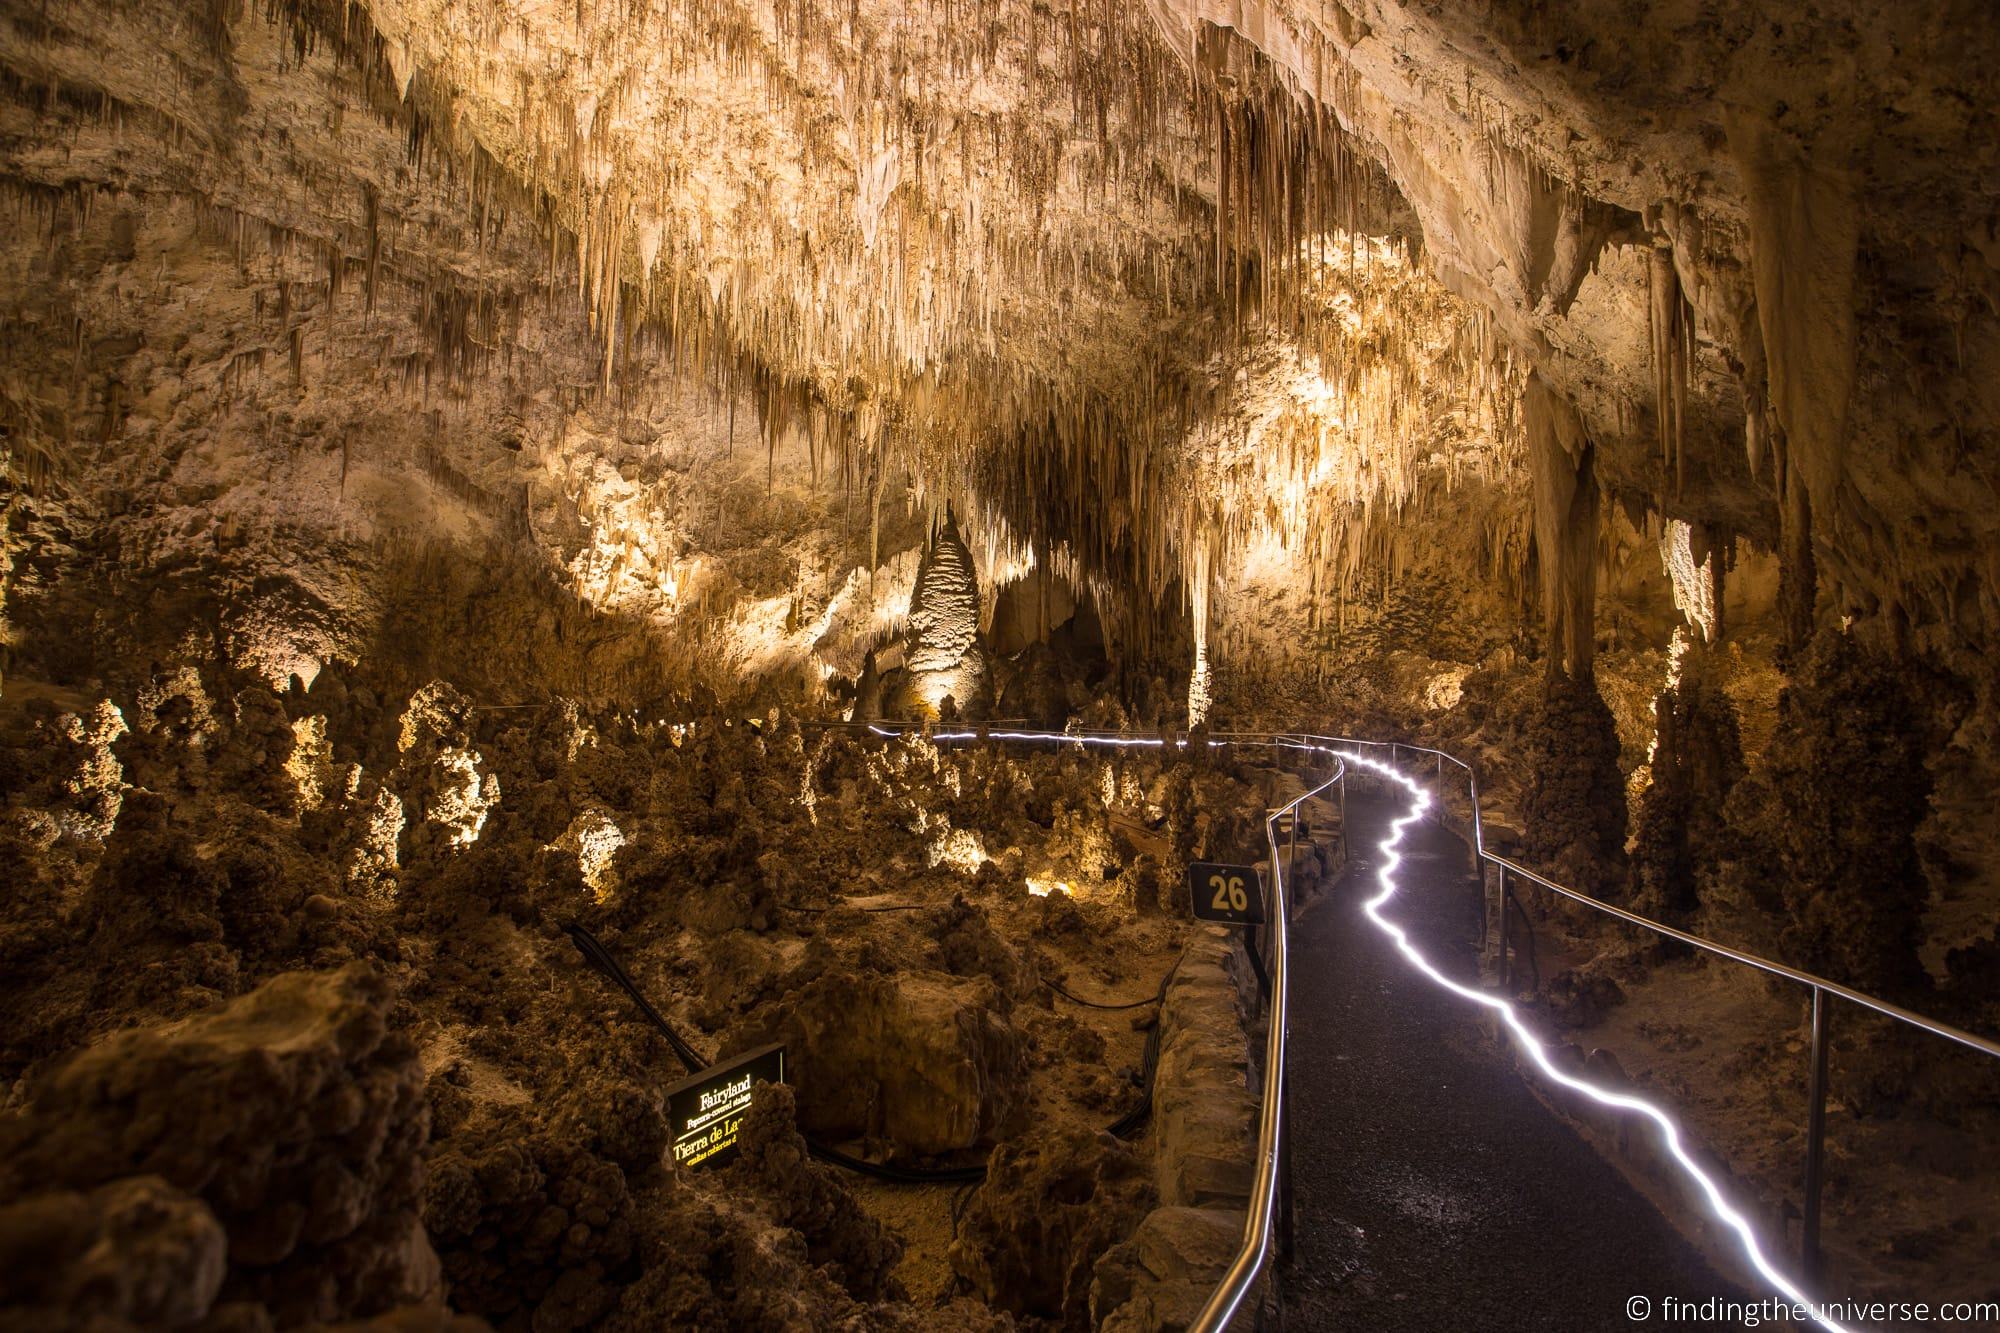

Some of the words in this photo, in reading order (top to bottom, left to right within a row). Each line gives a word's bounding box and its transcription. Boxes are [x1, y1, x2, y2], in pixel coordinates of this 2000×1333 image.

[1209, 875, 1248, 912] 26
[700, 1073, 751, 1112] Fairyland
[673, 1136, 708, 1160] Tierra
[710, 1126, 722, 1143] de
[724, 1118, 743, 1136] La
